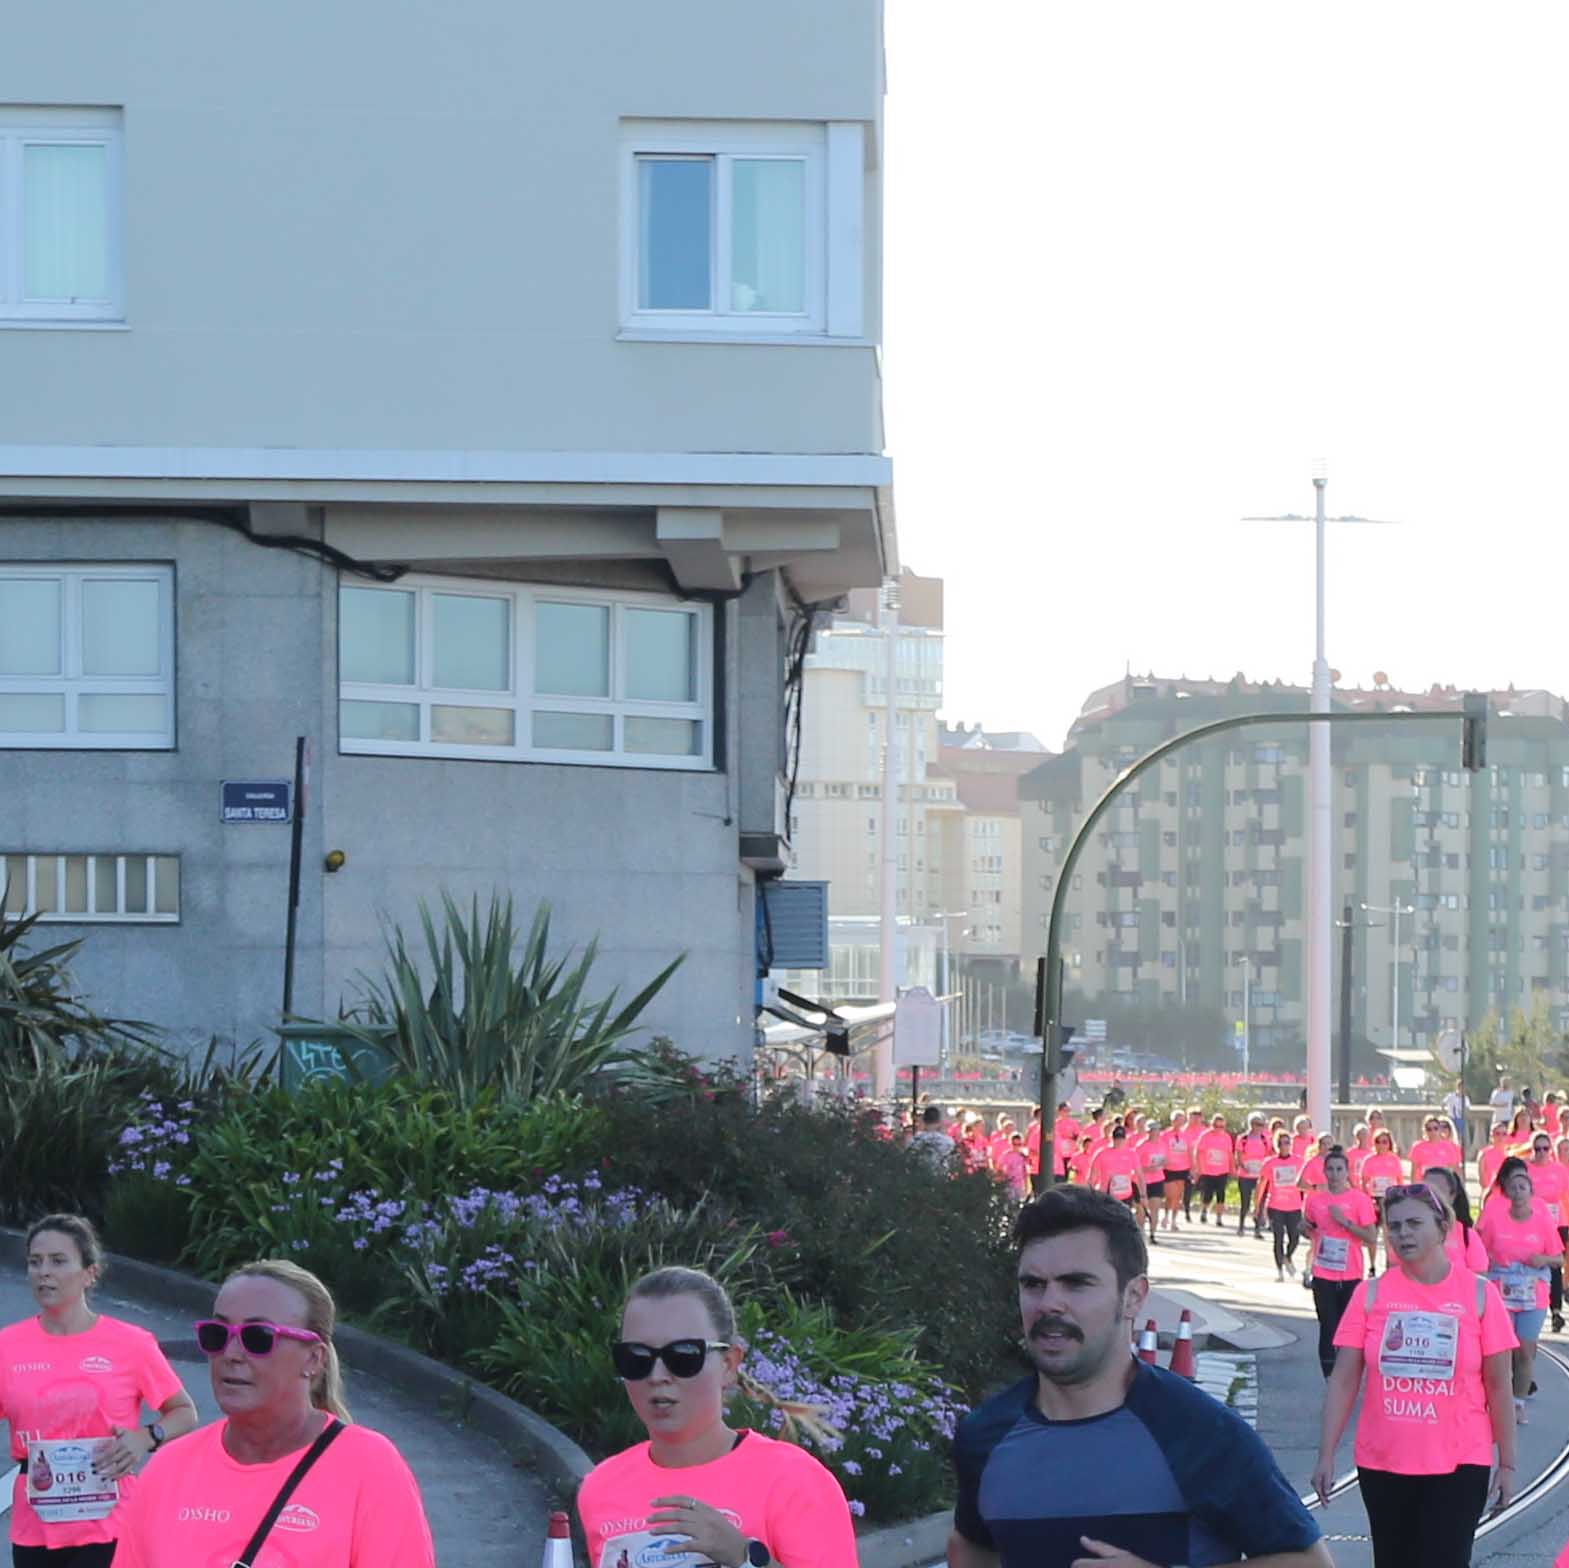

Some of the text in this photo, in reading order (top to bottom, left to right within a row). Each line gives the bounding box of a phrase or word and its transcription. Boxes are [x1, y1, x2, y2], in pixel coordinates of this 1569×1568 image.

[224, 807, 286, 819] SANTA TERESA
[1404, 1336, 1430, 1348] 016
[1383, 1377, 1456, 1396] DORSAL
[1383, 1398, 1437, 1418] SUMA
[55, 1471, 87, 1484] 016
[599, 1519, 647, 1537] OYSHO
